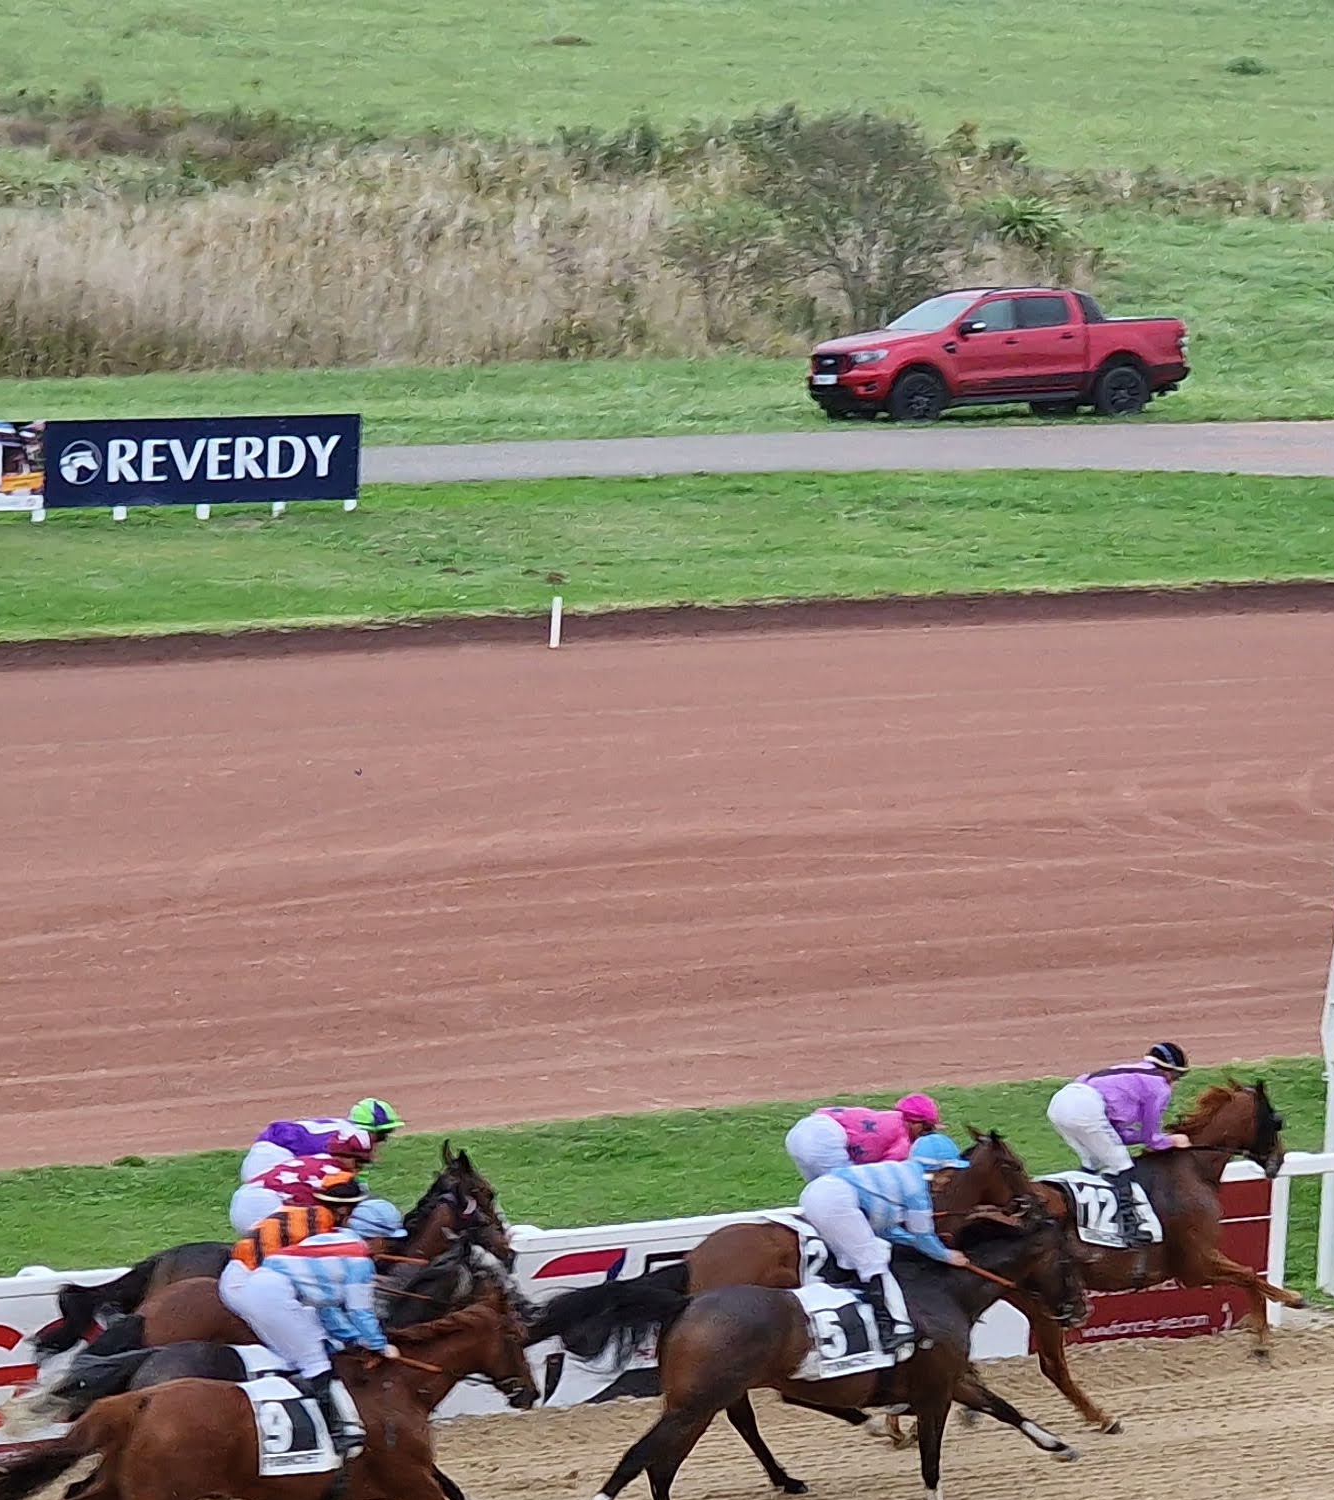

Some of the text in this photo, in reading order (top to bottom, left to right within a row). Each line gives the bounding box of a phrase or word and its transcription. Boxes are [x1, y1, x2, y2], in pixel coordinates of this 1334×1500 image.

[106, 434, 341, 483] REVERDY
[1076, 1184, 1119, 1234] 12
[804, 1238, 829, 1284] 2
[813, 1310, 848, 1359] 5
[258, 1401, 294, 1454] 9
